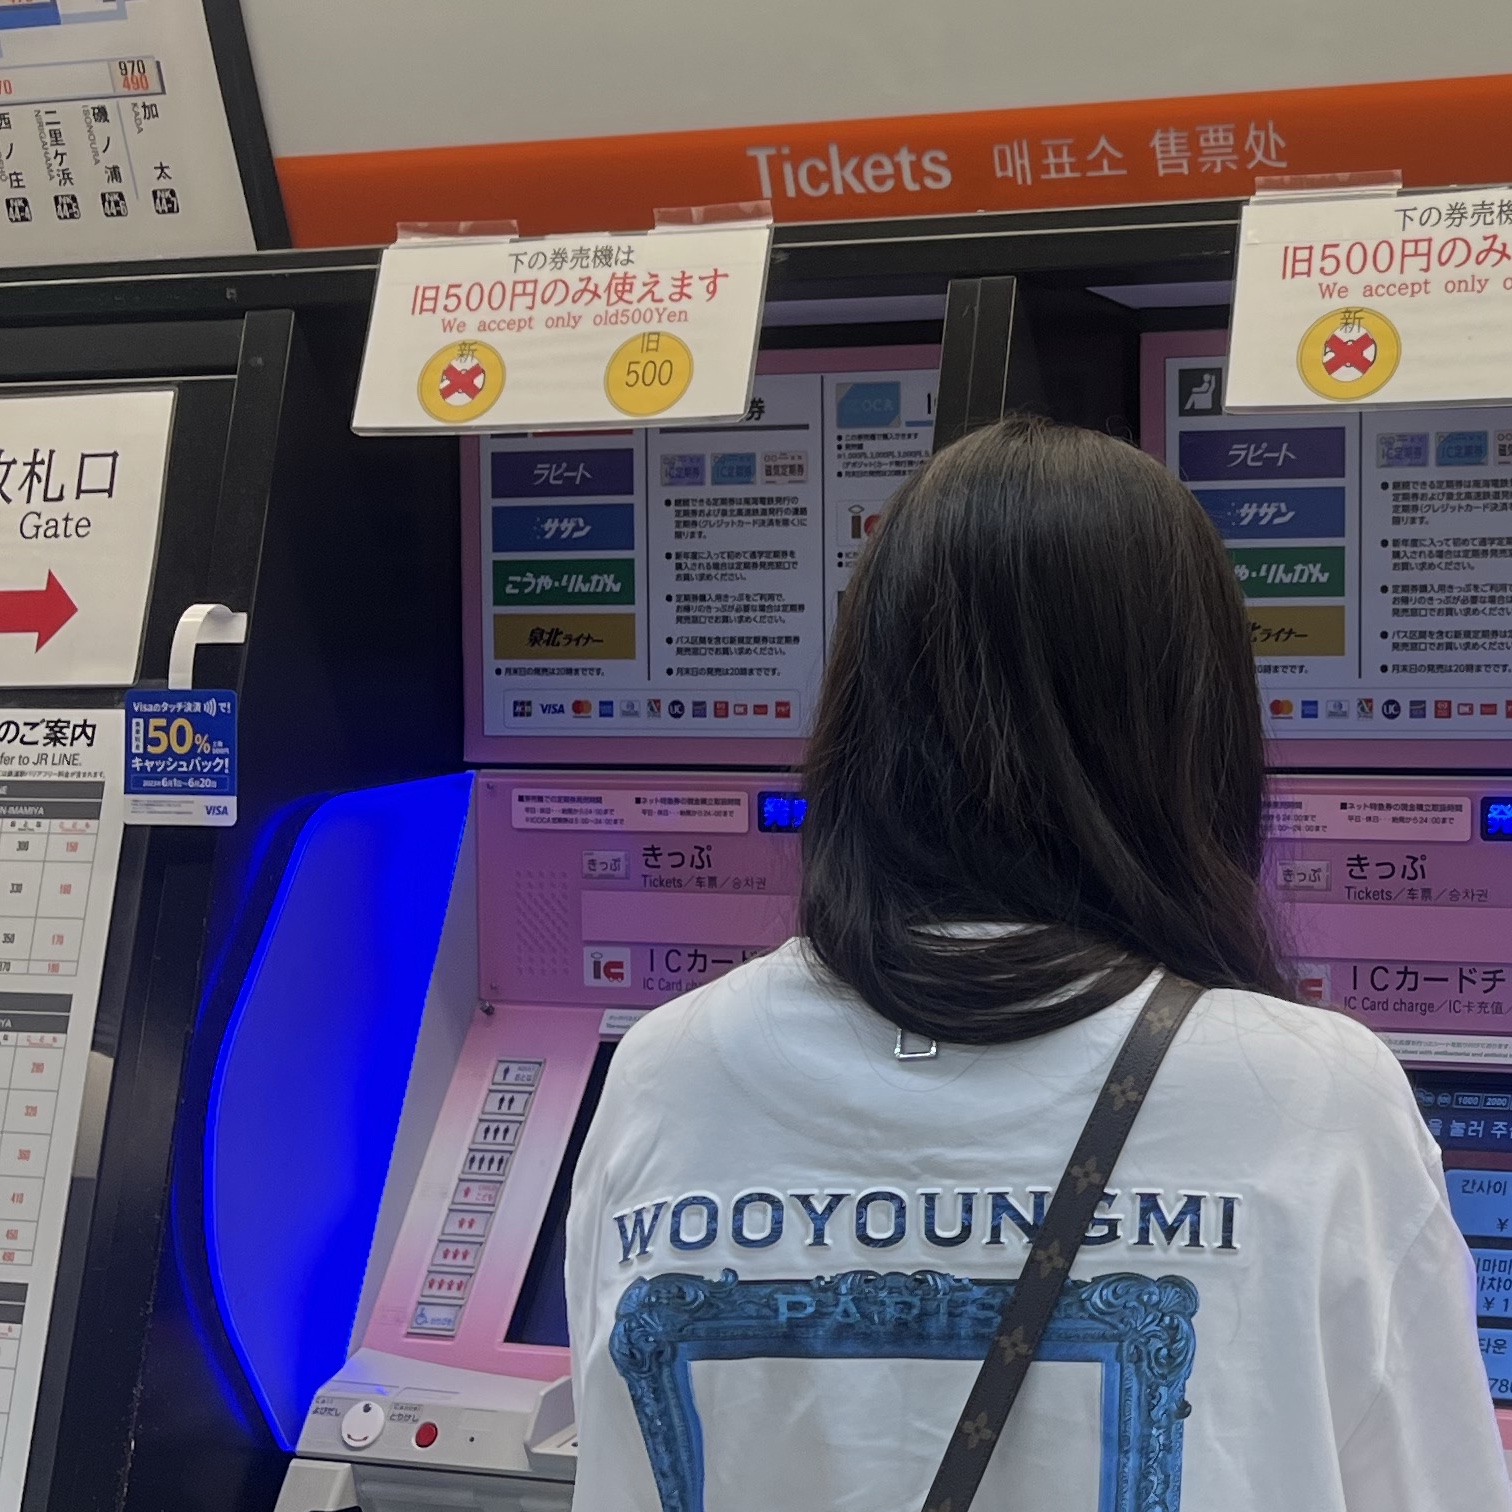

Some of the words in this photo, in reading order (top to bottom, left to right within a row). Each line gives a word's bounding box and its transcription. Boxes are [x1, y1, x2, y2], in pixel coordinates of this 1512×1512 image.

[118, 59, 147, 77] 970
[122, 75, 149, 91] 490
[992, 134, 1128, 186] 매표소
[1149, 119, 1288, 178] 售票处
[746, 142, 952, 200] Tickets
[507, 245, 637, 274] 下の券売機は
[410, 268, 730, 317] 旧500円のみ使えます
[1318, 281, 1349, 300] We
[1362, 277, 1431, 300] accept
[1444, 275, 1489, 295] only
[441, 317, 467, 333] We
[477, 314, 535, 334] accept
[543, 311, 584, 332] only
[592, 306, 690, 328] old500Yen
[624, 359, 674, 389] 500
[1225, 441, 1298, 468] ラピート
[532, 462, 593, 486] ラピート
[1236, 500, 1297, 526] サザン
[18, 510, 93, 541] Gate
[541, 517, 592, 540] サザン
[528, 627, 604, 647] 泉北ライナー
[540, 702, 565, 715] VISA
[18, 753, 30, 767] to
[32, 753, 49, 767] JR
[204, 804, 229, 816] VISA
[586, 857, 622, 873] きっぷ
[642, 844, 713, 869] きっぷ
[1344, 853, 1428, 882] きっぷ
[1281, 867, 1322, 884] きっぷ
[658, 978, 684, 992] Card
[1362, 997, 1391, 1012] Card
[1460, 1177, 1508, 1197] 간사이
